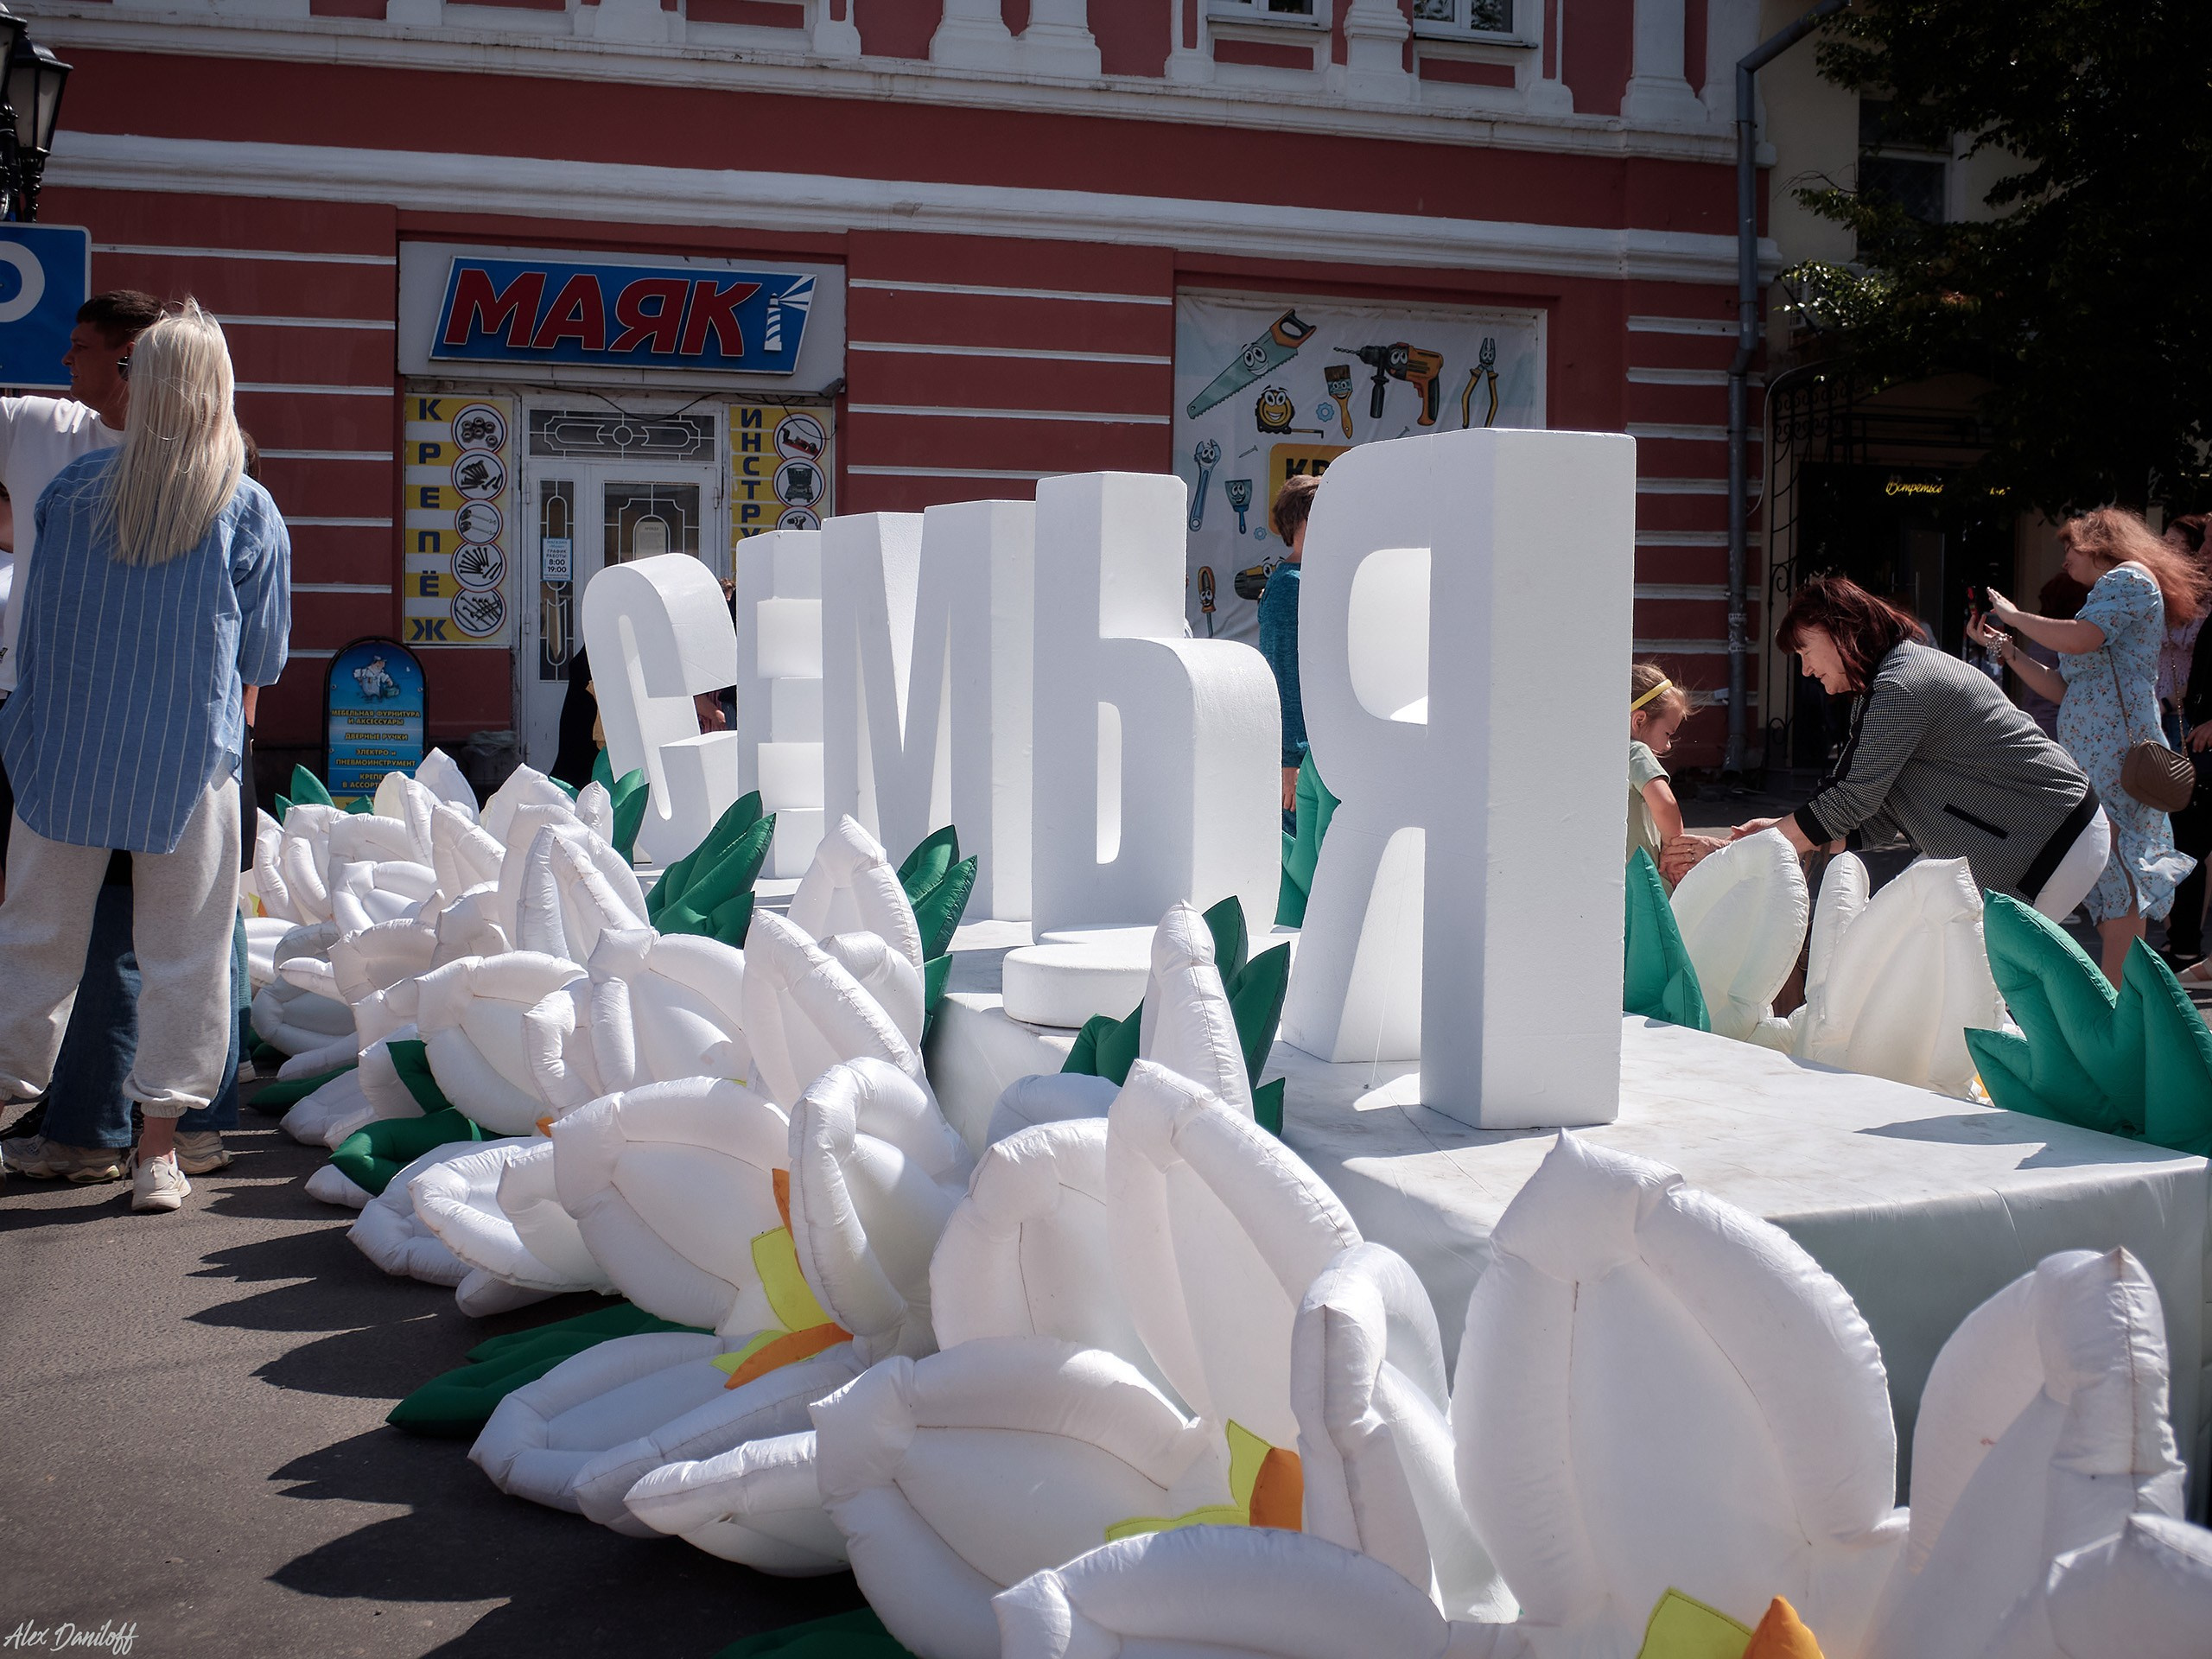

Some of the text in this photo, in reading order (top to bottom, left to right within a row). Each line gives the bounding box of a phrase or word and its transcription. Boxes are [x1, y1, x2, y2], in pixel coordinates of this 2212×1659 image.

[442, 268, 763, 357] МАЯК
[411, 398, 448, 641] КРЕПЁЖ
[376, 709, 421, 718] ФУРНИТУРА
[582, 428, 1636, 1129] СЕМЬЯ
